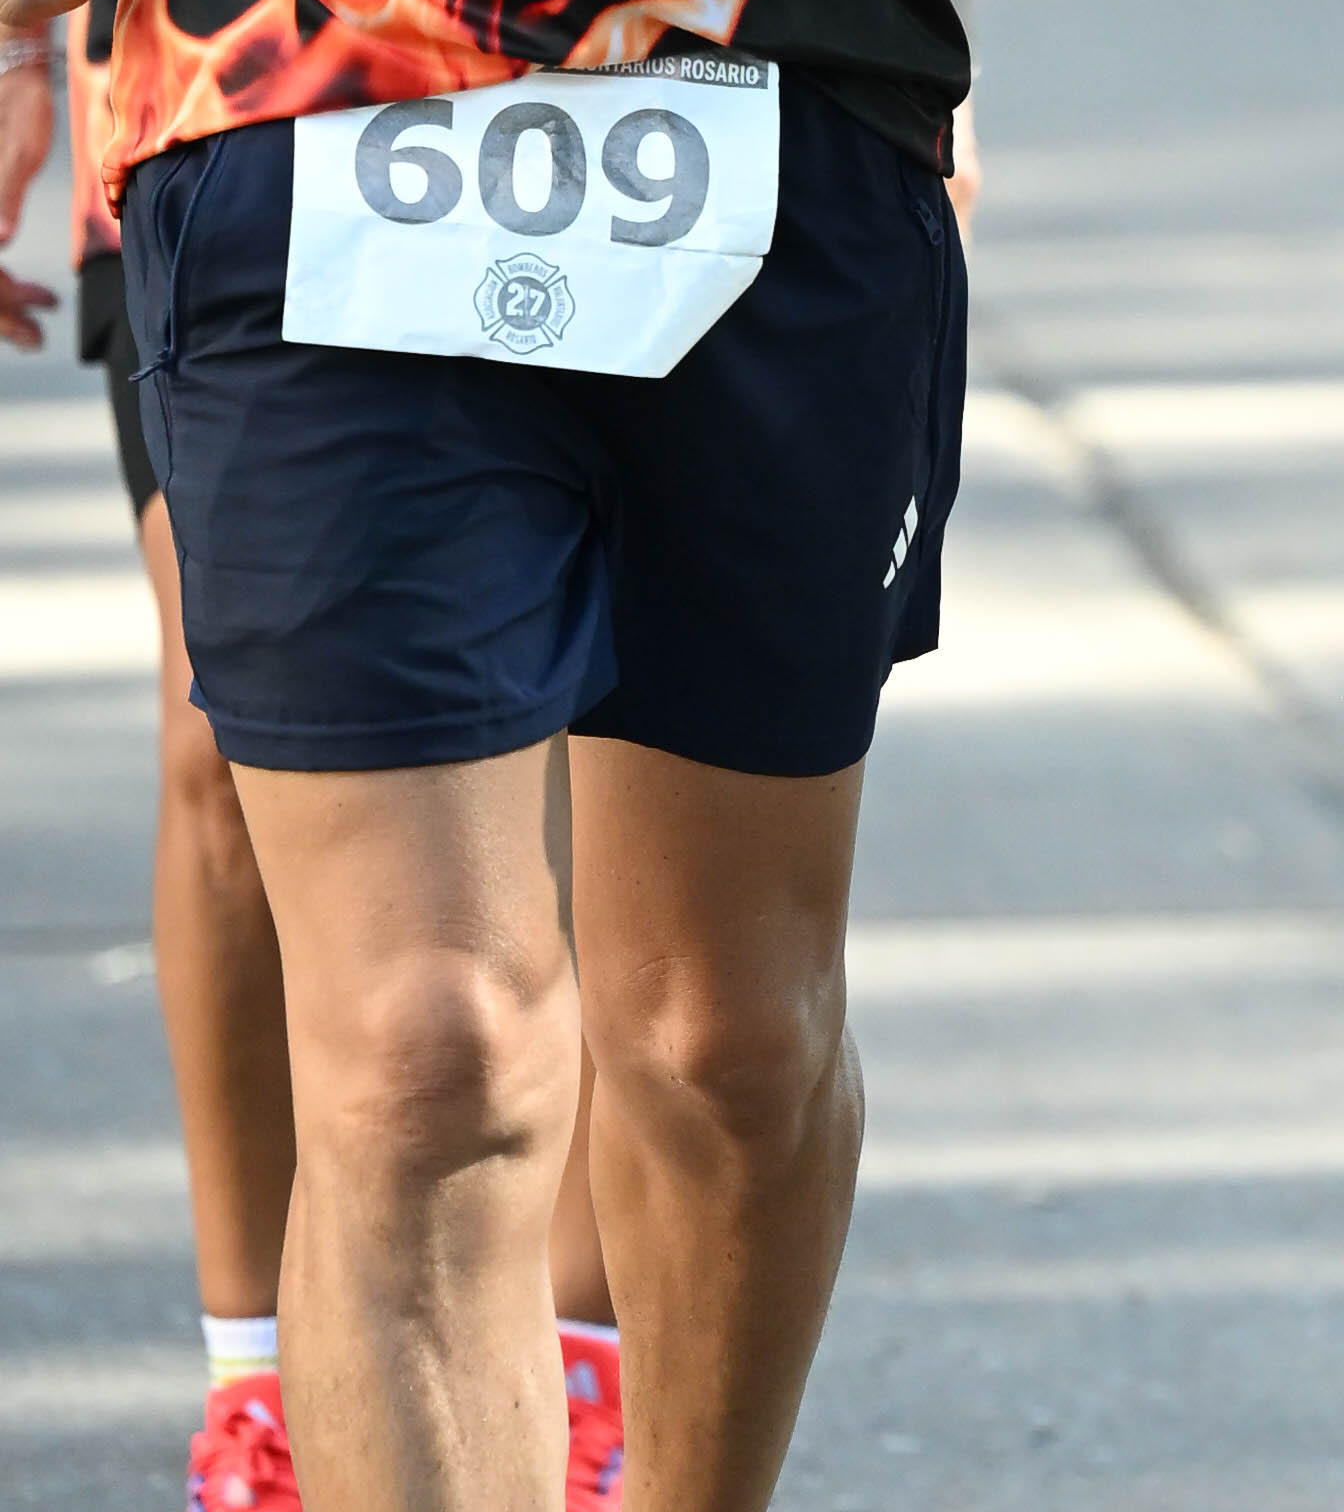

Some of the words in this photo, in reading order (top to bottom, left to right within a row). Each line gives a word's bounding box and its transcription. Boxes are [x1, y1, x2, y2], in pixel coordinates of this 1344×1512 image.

[680, 57, 758, 85] ROSARIO
[354, 98, 710, 248] 609
[506, 282, 547, 317] 27
